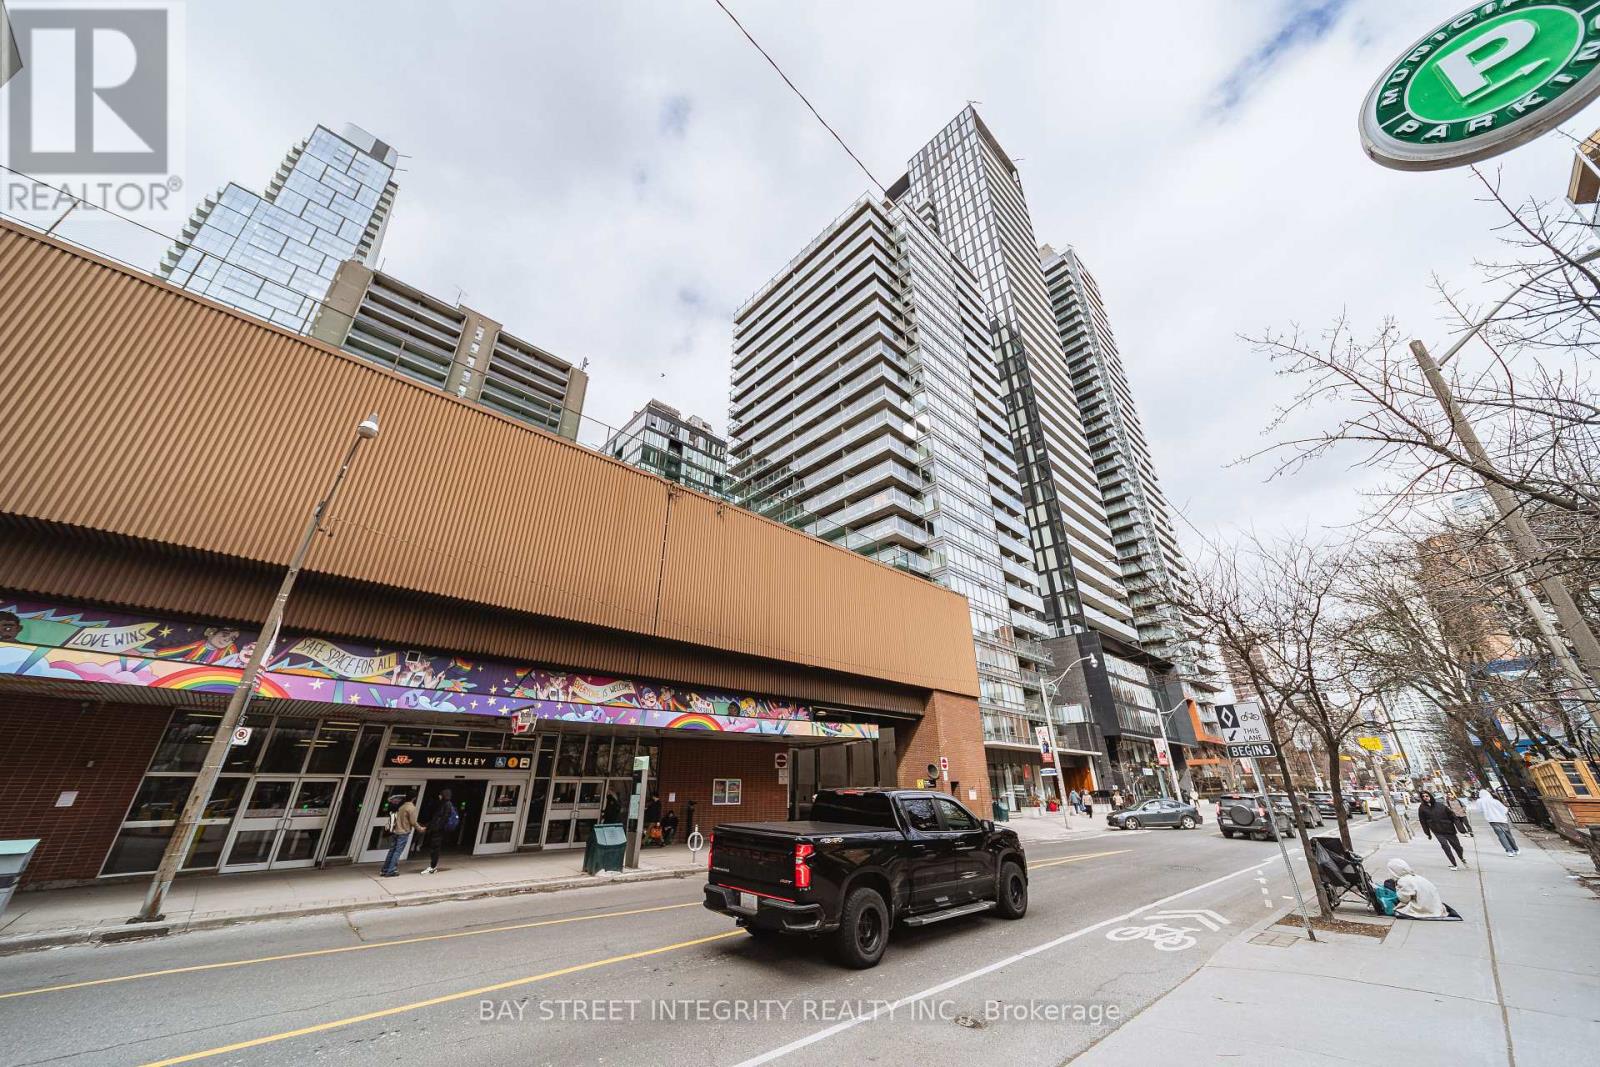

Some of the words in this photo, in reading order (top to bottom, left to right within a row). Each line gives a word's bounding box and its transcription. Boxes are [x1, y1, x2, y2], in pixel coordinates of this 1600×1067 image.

[1436, 20, 1537, 98] P
[1392, 14, 1600, 139] PARKIN
[72, 632, 111, 648] LOVE
[114, 627, 148, 646] WINS
[296, 639, 328, 657] SAFE
[323, 647, 356, 672] SPACE
[354, 657, 374, 674] FOR
[377, 655, 394, 671] ALL
[426, 756, 486, 766] WELLESLEY
[1231, 744, 1272, 757] BEGINS
